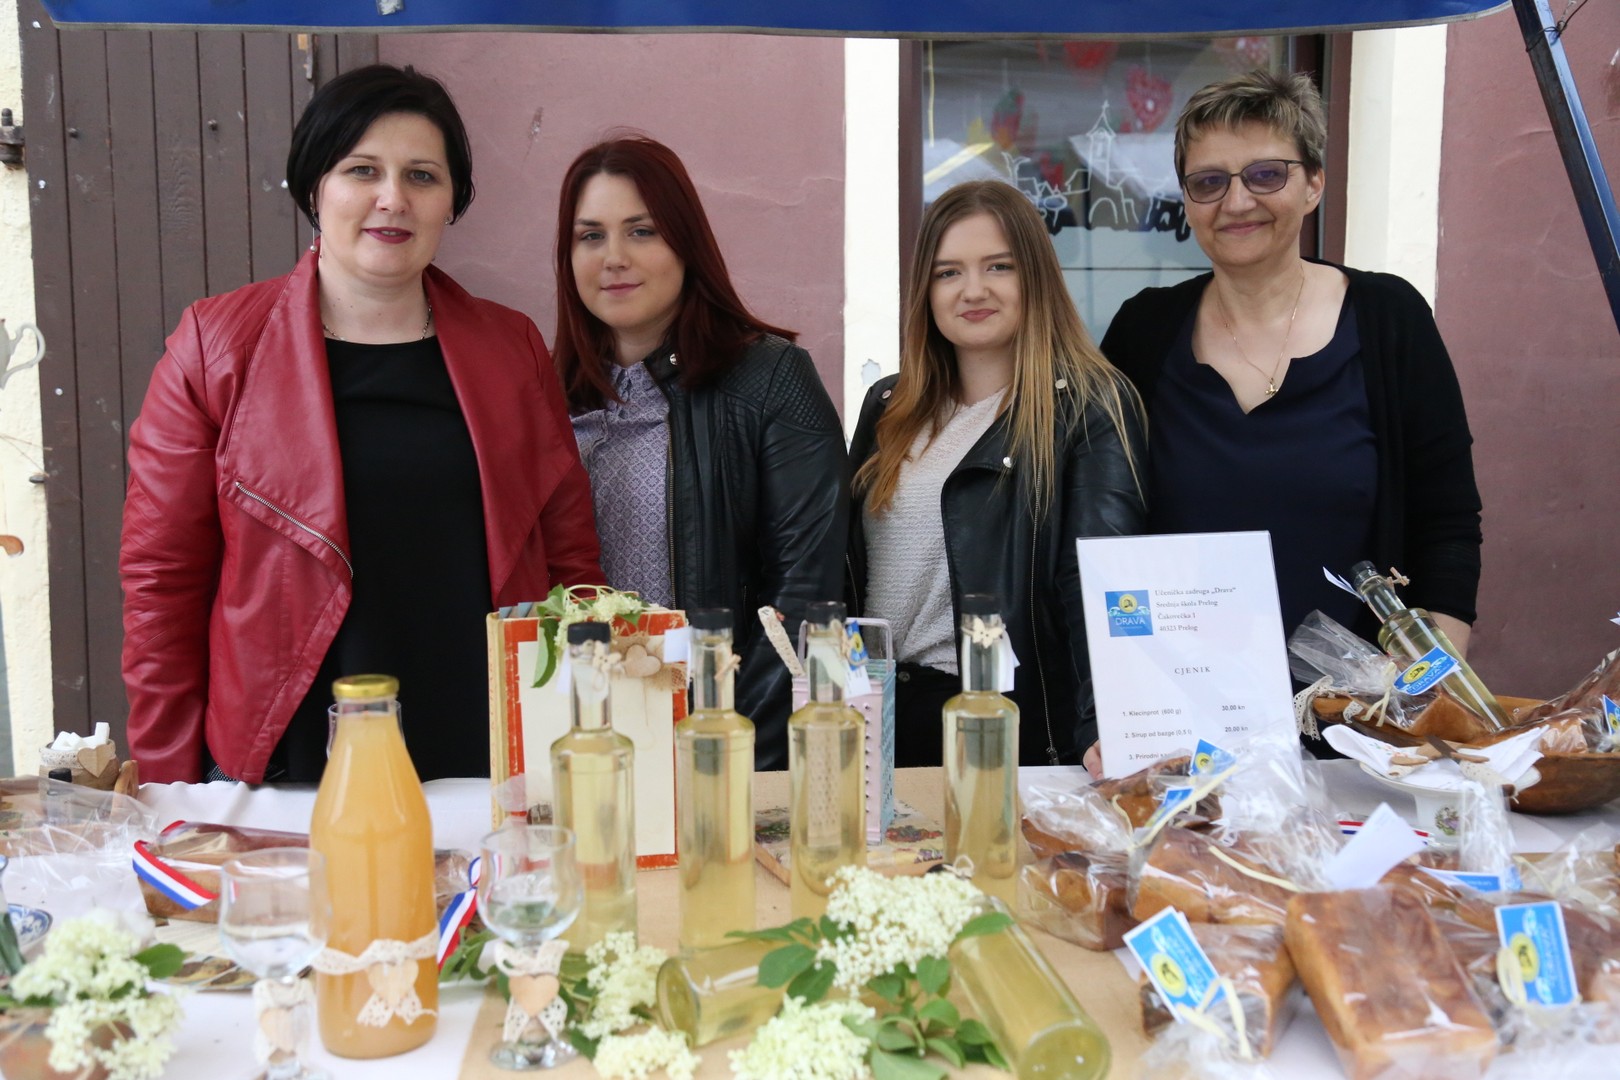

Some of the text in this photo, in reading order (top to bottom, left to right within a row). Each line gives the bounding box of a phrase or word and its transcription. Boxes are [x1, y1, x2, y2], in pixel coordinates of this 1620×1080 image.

[1116, 616, 1146, 626] DRAVA
[1178, 624, 1199, 632] Prelog
[1131, 731, 1148, 739] Sirup
[1135, 752, 1159, 760] Prirodni
